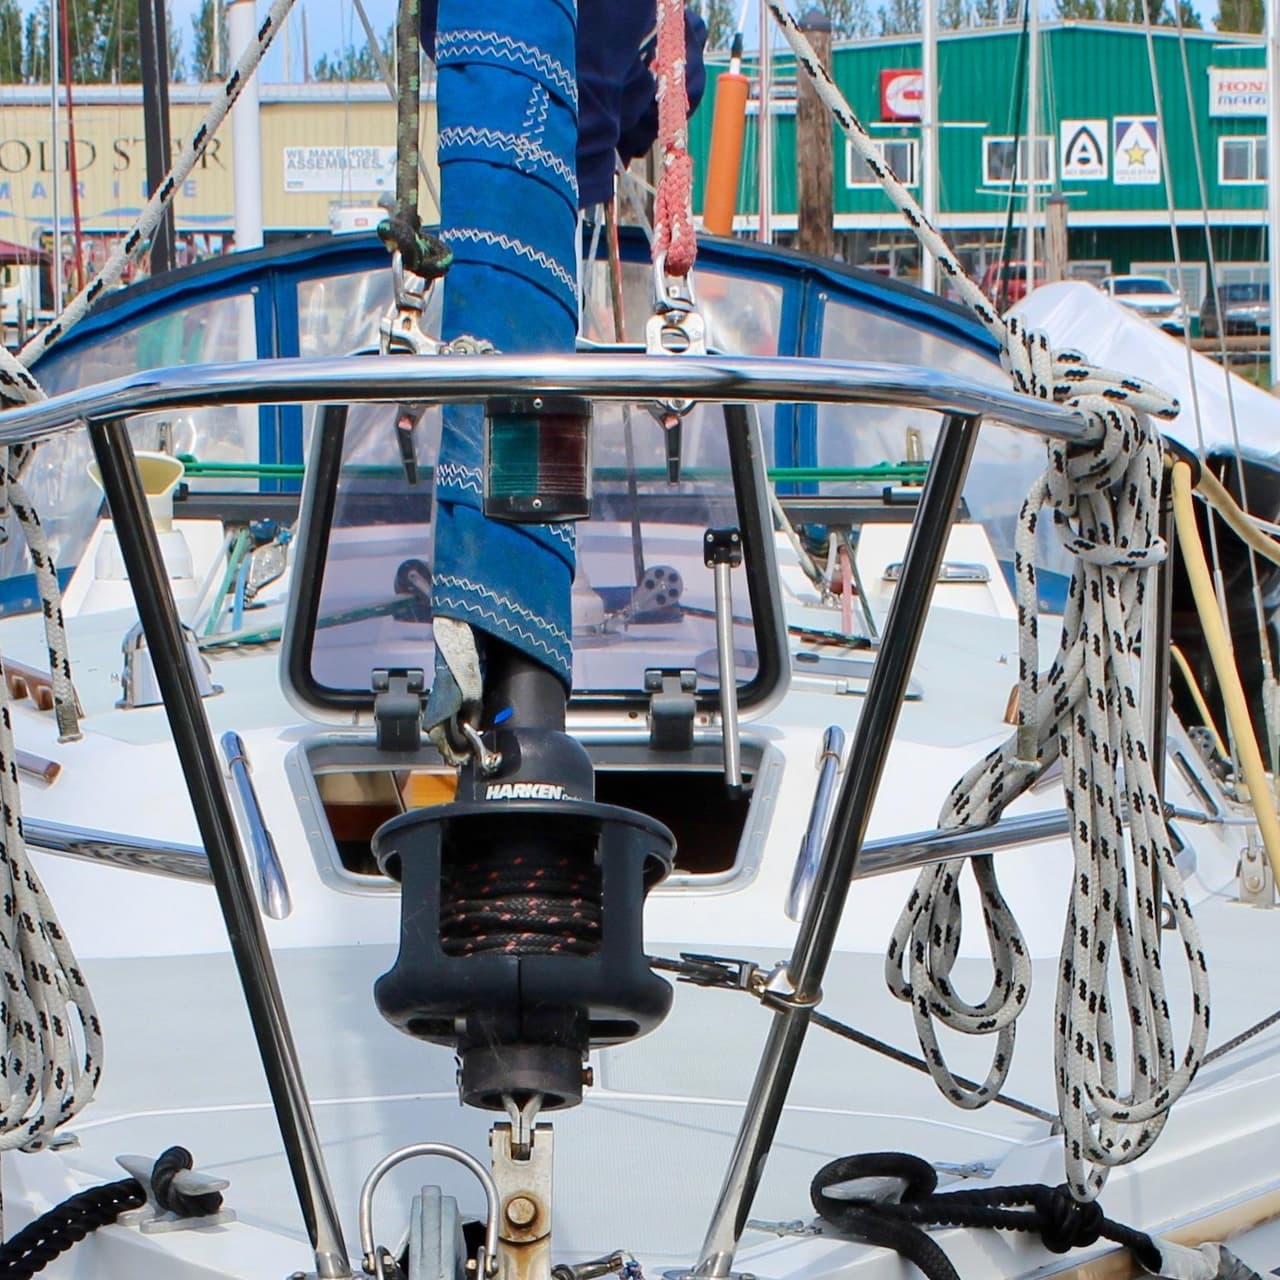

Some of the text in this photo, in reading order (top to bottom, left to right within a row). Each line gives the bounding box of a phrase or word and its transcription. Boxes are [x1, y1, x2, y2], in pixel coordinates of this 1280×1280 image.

[113, 137, 227, 170] SR
[286, 149, 379, 159] WE MAKE HOSE
[486, 783, 562, 800] HARKEN
